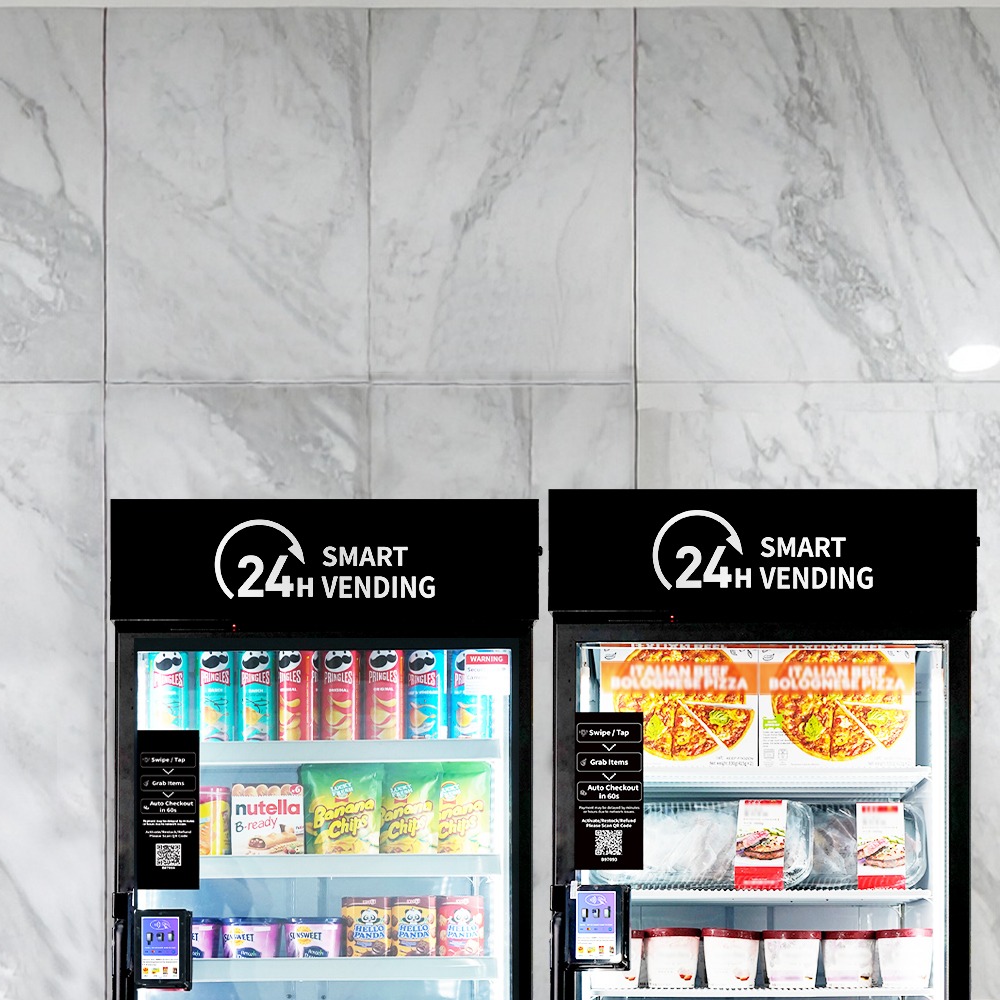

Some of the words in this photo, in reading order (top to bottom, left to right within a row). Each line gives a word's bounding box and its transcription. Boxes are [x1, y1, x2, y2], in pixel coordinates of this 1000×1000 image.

[760, 537, 846, 558] SMART
[322, 546, 409, 567] SMART
[759, 566, 874, 590] VENDING
[321, 575, 435, 599] VENDING
[200, 670, 230, 686] PRINGLES
[241, 670, 270, 685] PRINGLES
[324, 671, 353, 684] PRINGLES
[368, 671, 398, 684] PRINGLES
[630, 665, 692, 678] ITALIAN
[788, 666, 848, 678] ITALIAN
[408, 672, 436, 688] PRINGLES
[704, 677, 748, 690] PIZZA
[862, 677, 905, 690] PIZZA
[589, 729, 611, 737] Swipe
[616, 729, 629, 737] Tap
[236, 799, 300, 816] nutella
[313, 799, 375, 829] Banana
[438, 800, 484, 823] nana
[236, 817, 277, 832] B-ready
[328, 814, 369, 840] Chips
[388, 816, 428, 840] Chips
[438, 815, 478, 840] Chips
